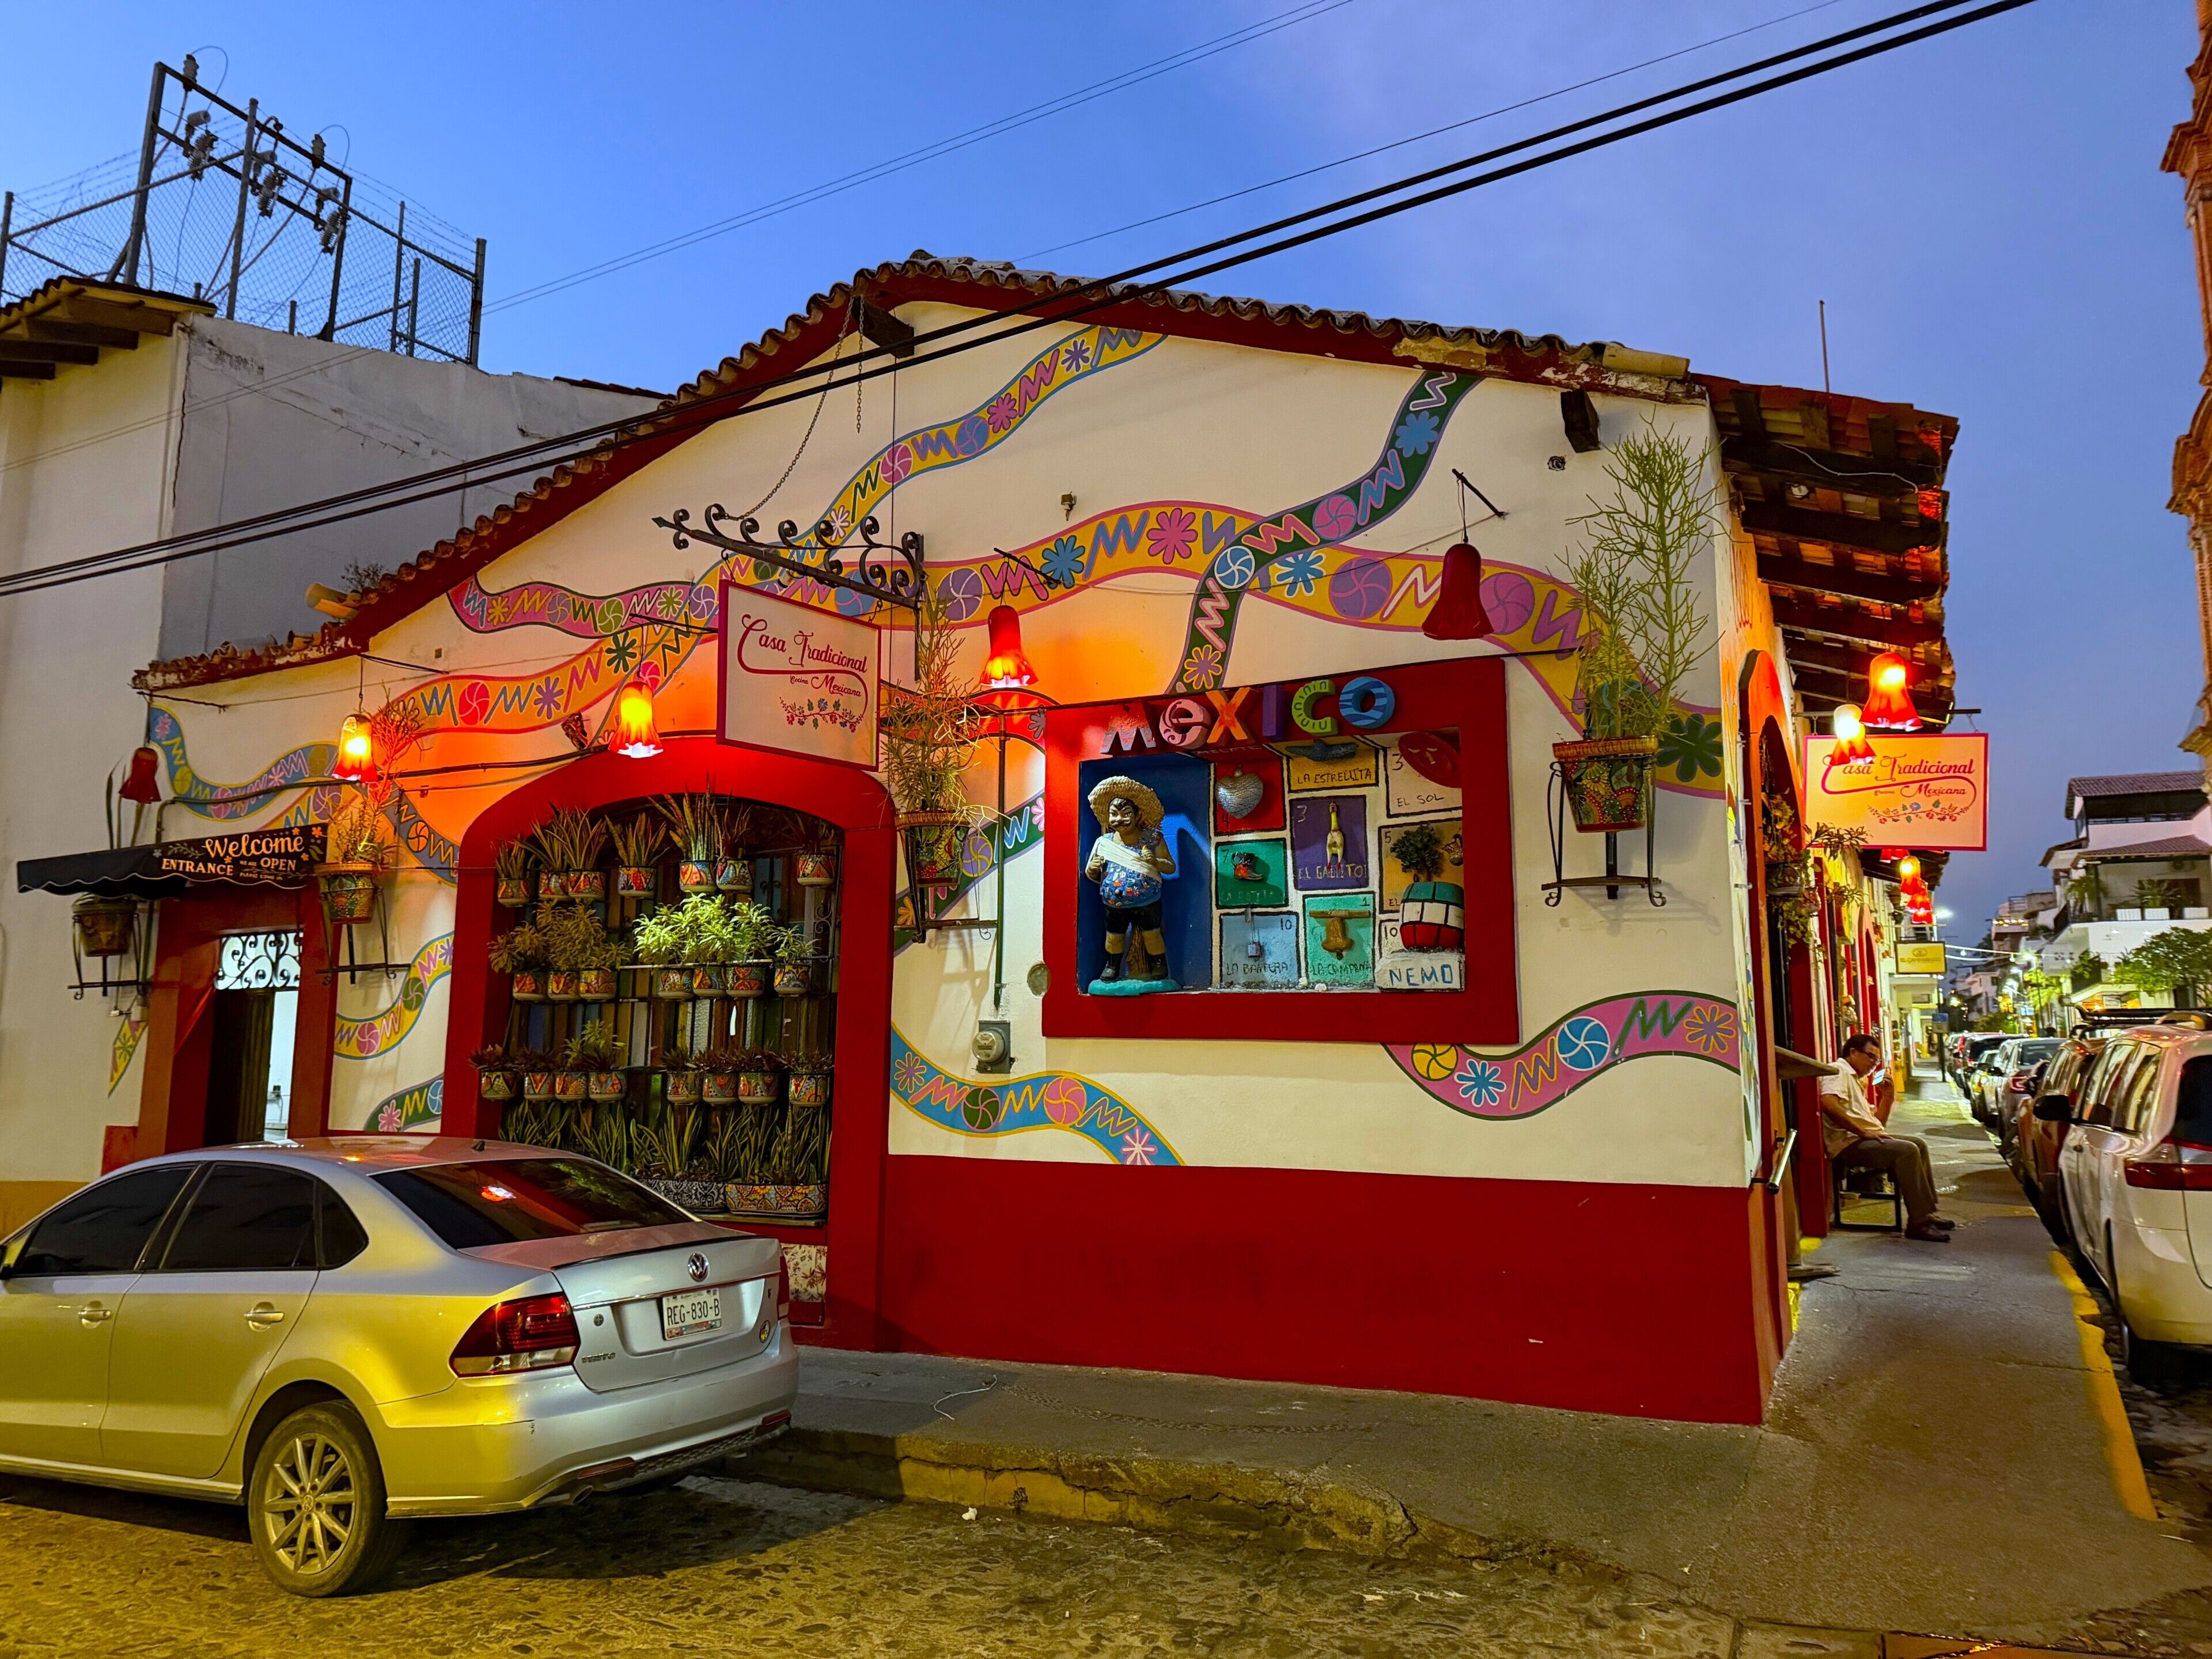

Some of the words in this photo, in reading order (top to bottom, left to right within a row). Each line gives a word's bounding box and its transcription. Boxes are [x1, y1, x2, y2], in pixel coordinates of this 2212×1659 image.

[737, 614, 787, 668] Casa
[789, 630, 868, 673] Tradicional
[790, 675, 809, 684] Cocina
[811, 674, 862, 696] Mexicana
[1392, 753, 1404, 771] 3
[1874, 753, 1975, 782] Tradicional
[1297, 774, 1310, 783] LA
[1900, 782, 1967, 798] Mexicana
[1397, 797, 1410, 807] EL
[1416, 793, 1445, 804] SOL
[1297, 805, 1308, 823] 3
[1384, 831, 1392, 844] 5
[202, 834, 305, 858] Welcome
[260, 857, 297, 871] OPEN
[1221, 849, 1230, 864] 7
[161, 858, 233, 876] ENTRANCE
[1298, 866, 1311, 880] EL
[1281, 918, 1293, 931] 10
[1384, 925, 1398, 940] 10
[1226, 963, 1238, 975] LA
[1389, 963, 1453, 987] NEMO
[666, 1298, 720, 1326] REG-830-B
